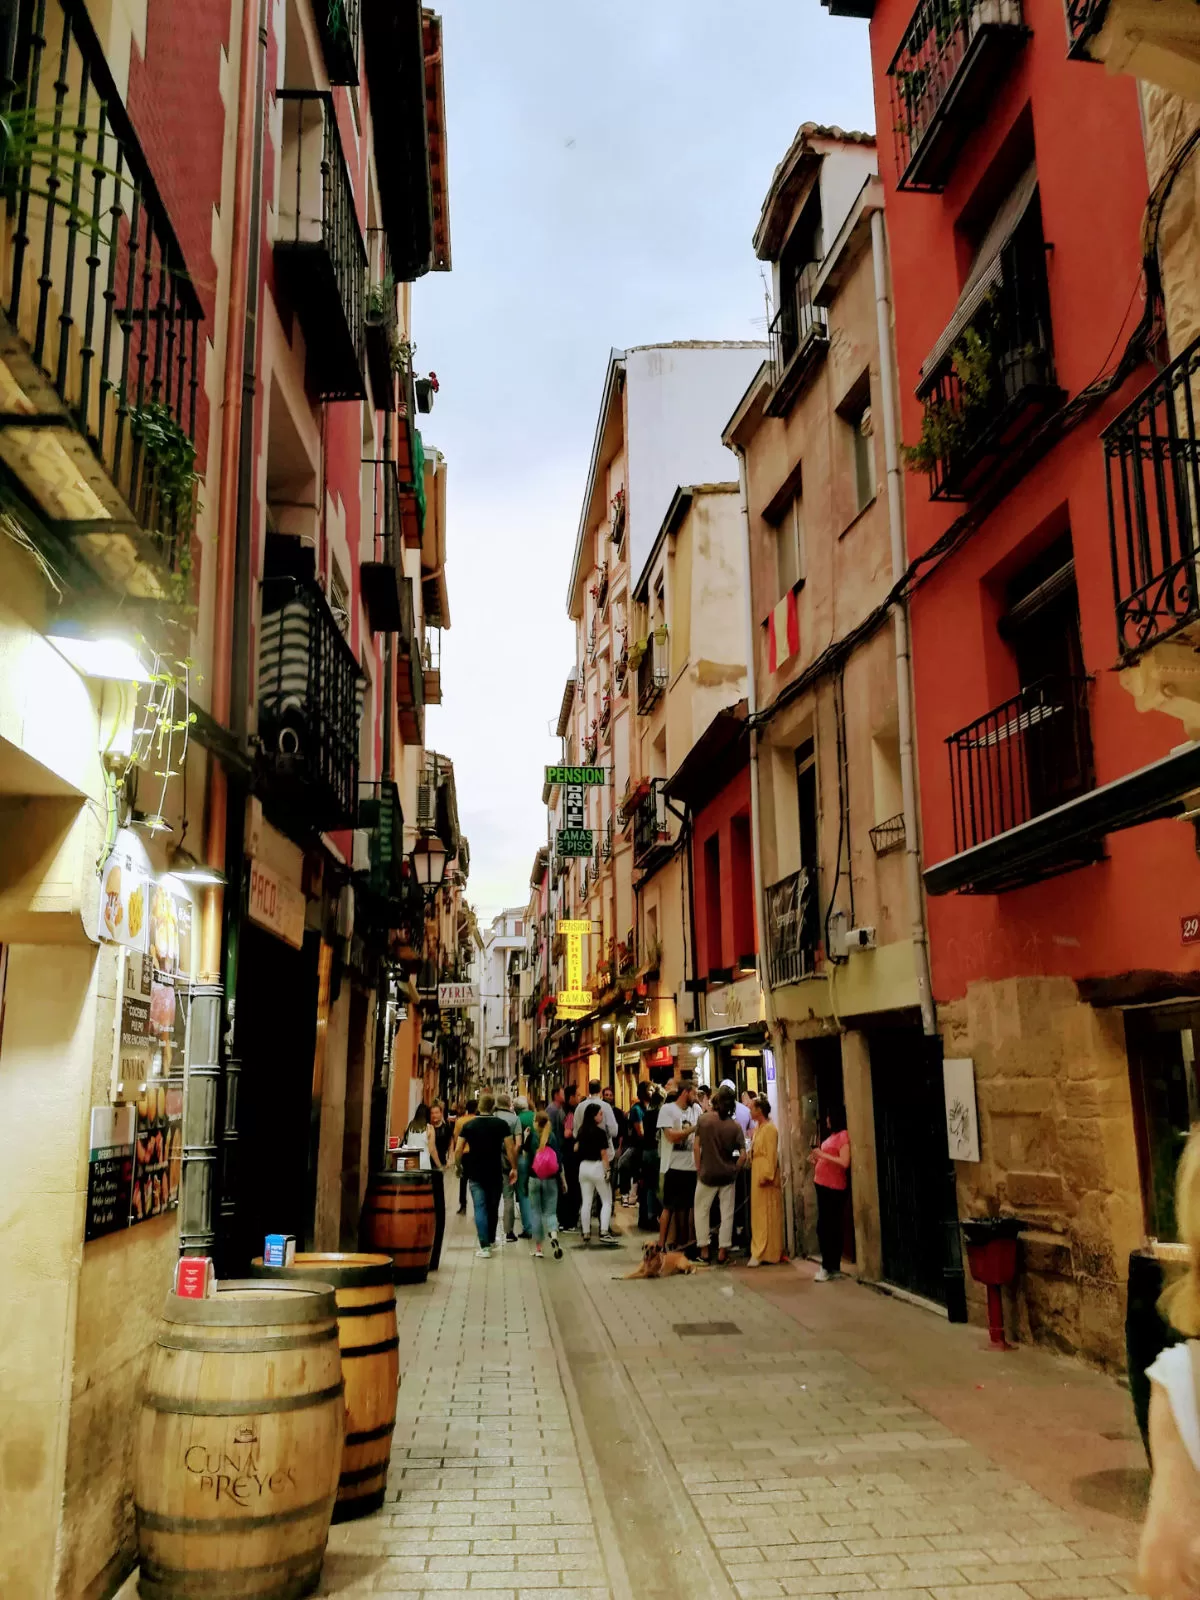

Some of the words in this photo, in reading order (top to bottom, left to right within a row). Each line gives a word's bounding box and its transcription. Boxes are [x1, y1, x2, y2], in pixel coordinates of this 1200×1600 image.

[547, 767, 604, 783] PENSION
[568, 785, 583, 829] DANIEL
[558, 830, 593, 841] CAMAS
[567, 841, 593, 851] PISO
[250, 870, 277, 919] PACO
[559, 922, 590, 932] PENSION
[1183, 919, 1199, 937] 29
[559, 993, 591, 1004] CAMAS
[185, 1444, 258, 1478] CUNA
[215, 1467, 298, 1507] REYES
